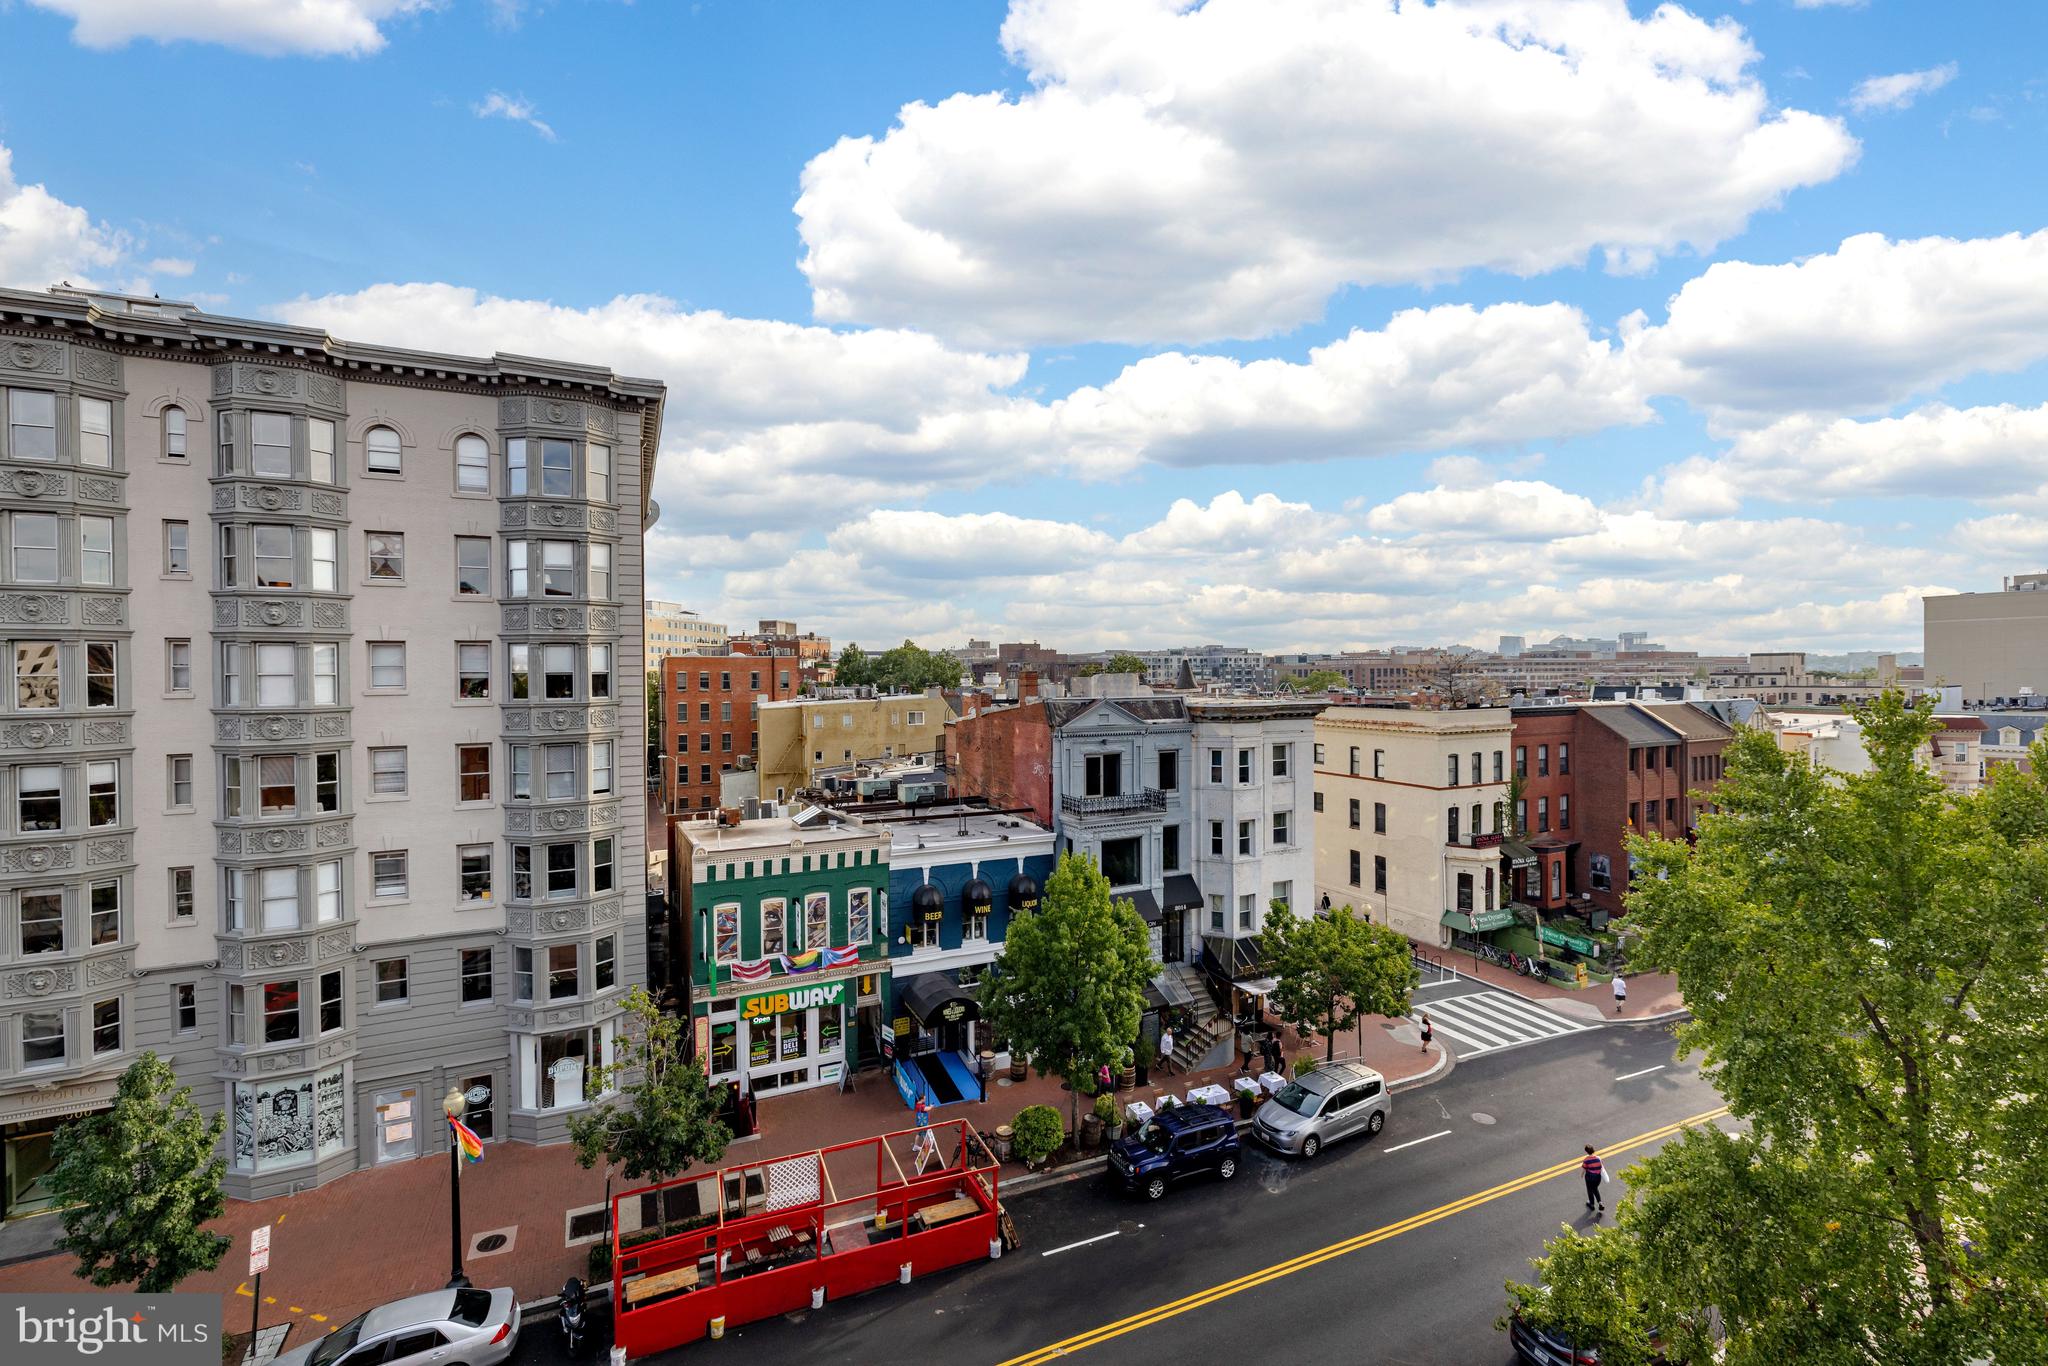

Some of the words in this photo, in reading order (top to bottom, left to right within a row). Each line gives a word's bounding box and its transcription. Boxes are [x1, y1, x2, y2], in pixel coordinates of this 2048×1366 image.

[975, 905, 991, 914] WINE
[924, 911, 943, 921] BEER
[742, 983, 844, 1019] SUBWAY
[753, 1016, 771, 1025] Open
[783, 1042, 798, 1050] DELI
[548, 1062, 583, 1076] DUPONT
[20, 1085, 97, 1105] TORONTO
[464, 1088, 491, 1099] DUPONT
